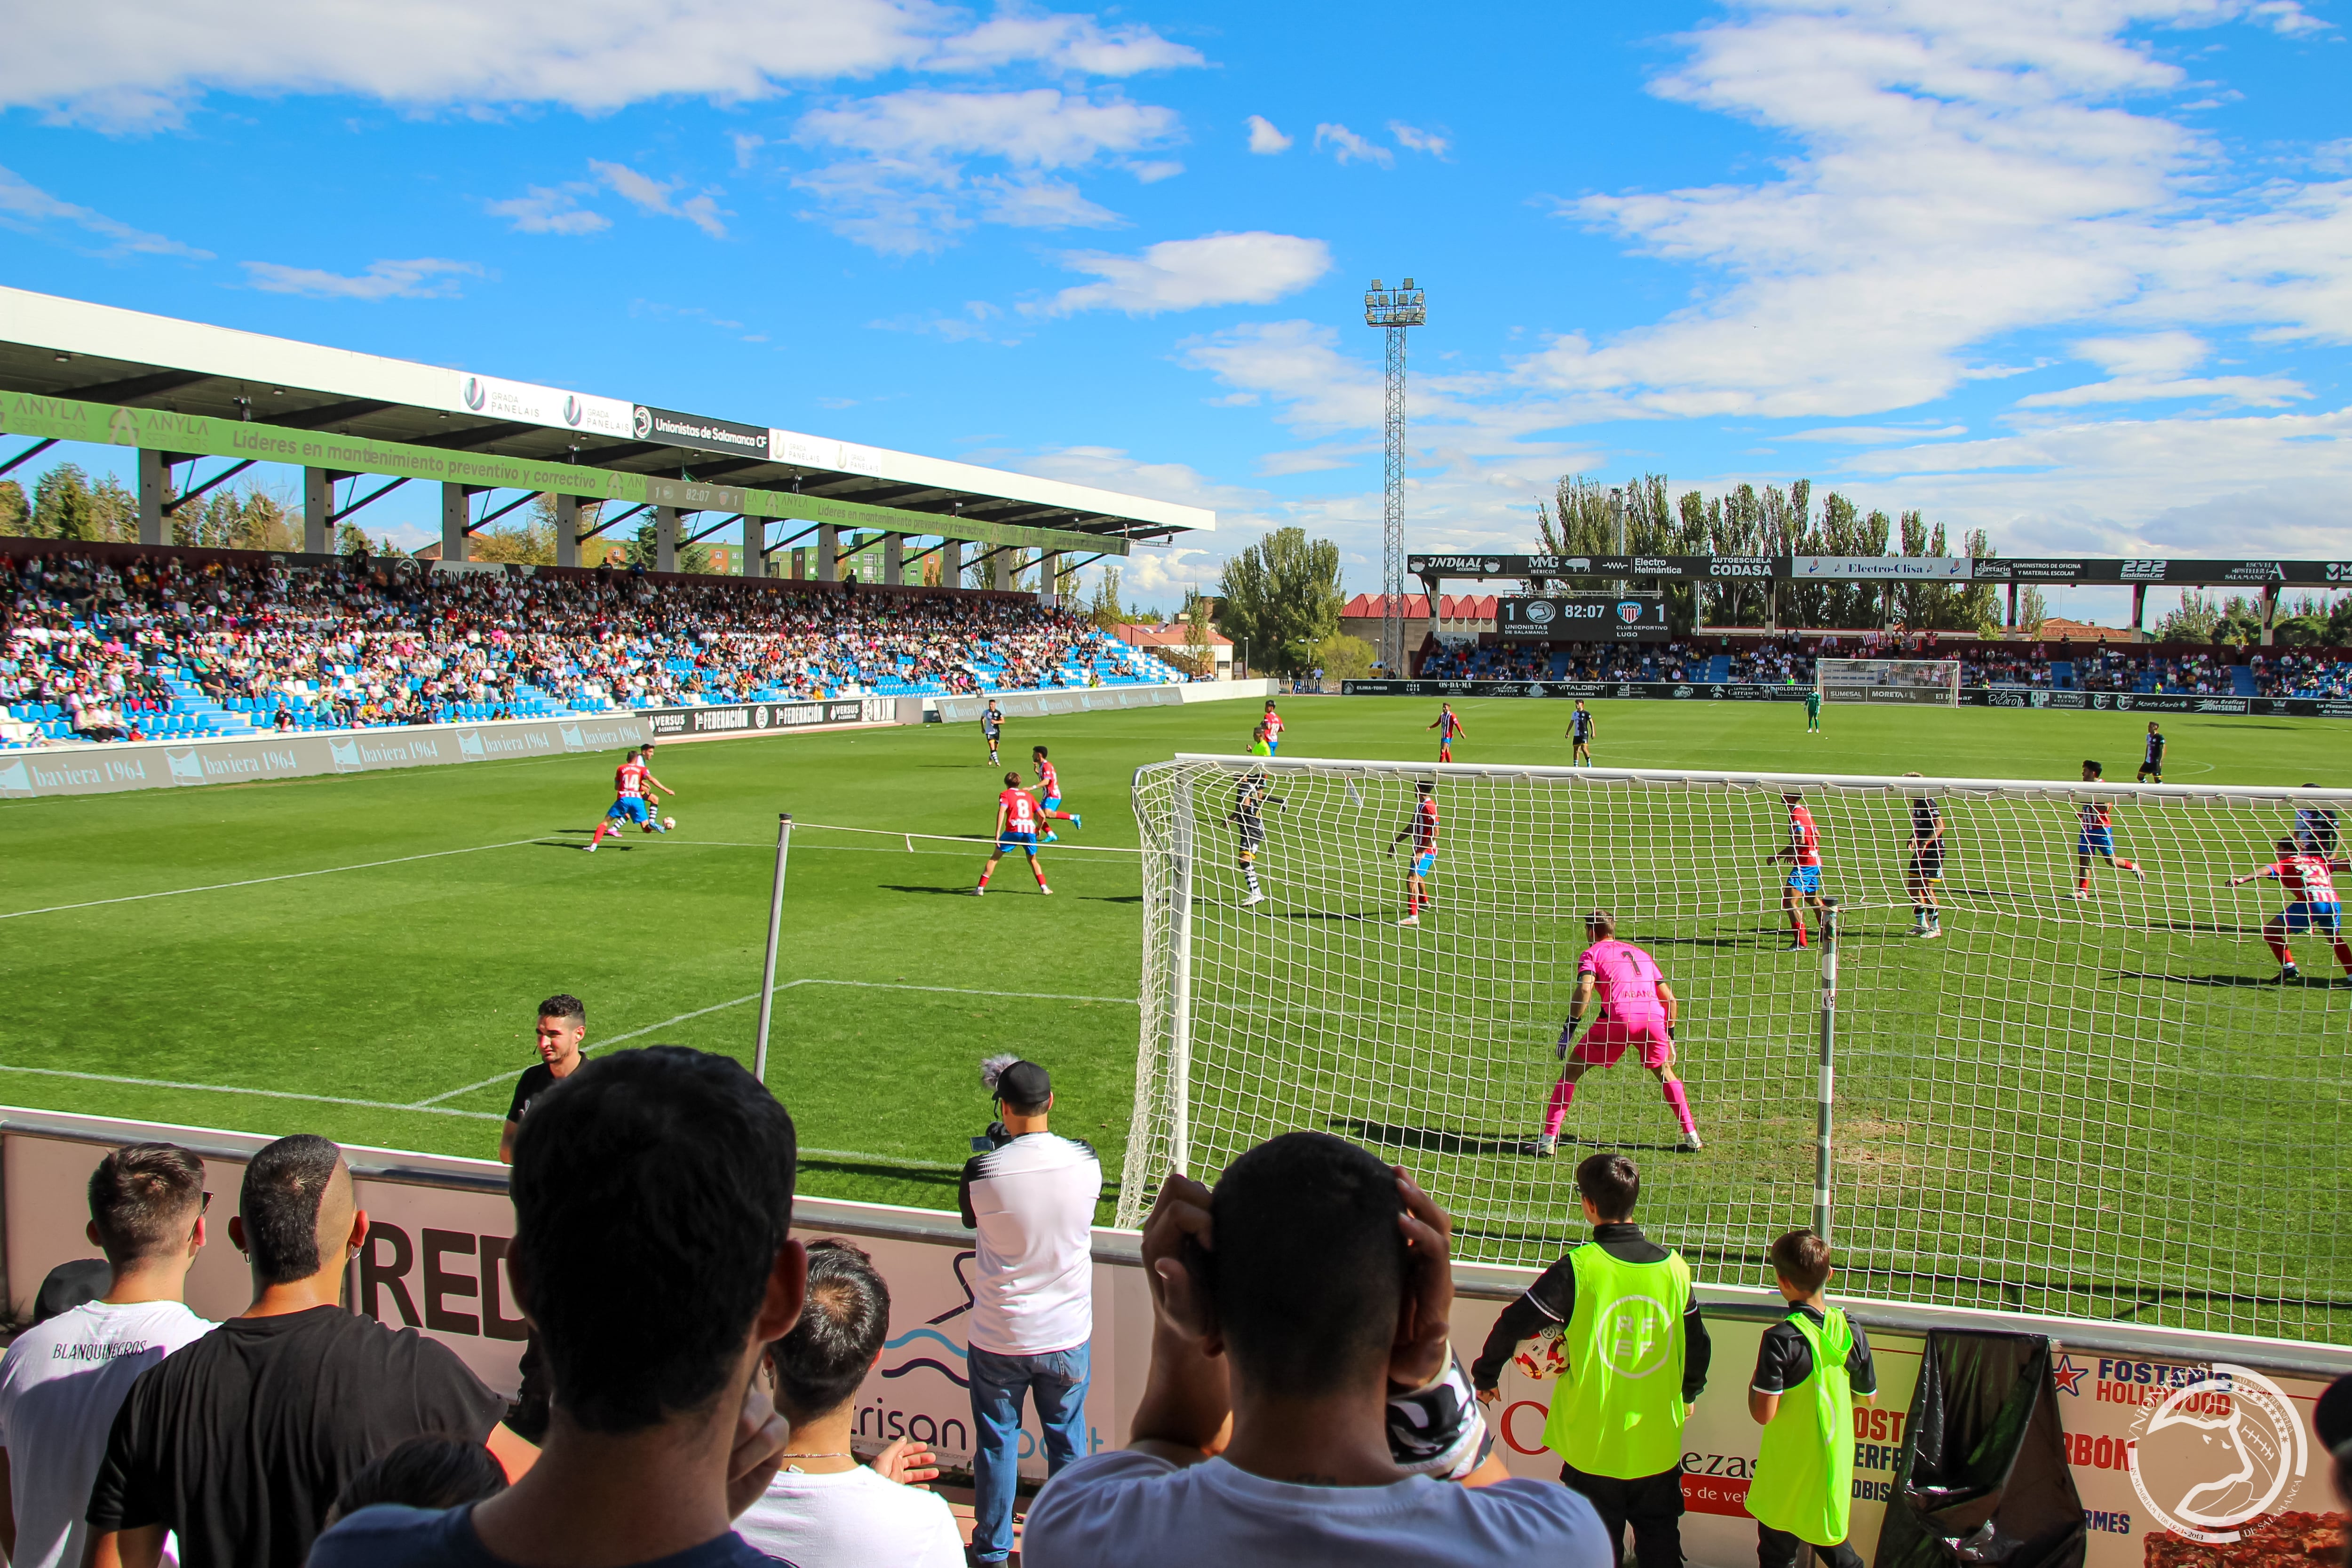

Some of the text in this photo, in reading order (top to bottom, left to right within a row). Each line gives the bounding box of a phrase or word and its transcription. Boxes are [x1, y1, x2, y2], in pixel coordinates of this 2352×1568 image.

[492, 392, 518, 404] GRADA
[491, 402, 540, 418] PANELAIS
[587, 409, 610, 419] GRADA
[587, 417, 629, 432] PANELAIS
[655, 417, 767, 449] Unionistas de Salamanca CF
[789, 443, 806, 452] GRADA
[233, 429, 596, 489] Líderes en mantenimiento preventivo y correctivo
[789, 451, 819, 463] PANELAIS
[850, 461, 878, 472] PANELAIS
[655, 487, 660, 499] 1
[686, 488, 710, 503] 82:07
[733, 495, 738, 507] 1
[818, 503, 846, 519] Líderes
[848, 511, 857, 520] en
[859, 512, 912, 527] mantenimiento
[914, 519, 947, 532] preventivo
[954, 524, 985, 536] correctivo
[1428, 557, 1481, 568] INDUAL
[1528, 556, 1559, 568] MMG
[1635, 566, 1682, 574] Helmántica
[1848, 563, 1923, 574] Electro-Clisa
[2121, 560, 2167, 572] 222
[1710, 565, 1773, 576] CODASA
[1506, 603, 1664, 622] 1 82:07 1
[783, 703, 824, 724] FEDERACIÓN
[835, 704, 859, 714] VERSUS
[654, 714, 686, 726] VERSUS
[704, 707, 749, 730] FEDERACIÓN
[582, 725, 642, 745] baviera 1964
[1270, 723, 1279, 736] 18
[483, 731, 548, 753] baviera 1964
[360, 739, 438, 762] baviera 1964
[203, 749, 297, 776] baviera 1964
[32, 759, 146, 787] baviera 1964
[622, 774, 640, 791] 14
[1016, 799, 1029, 818] 8
[53, 1340, 148, 1361] BLANQUINEGROS
[2098, 1357, 2233, 1394] FOSTER'S
[2096, 1380, 2231, 1416] HOLLYWOOD
[1697, 1487, 1717, 1500] de
